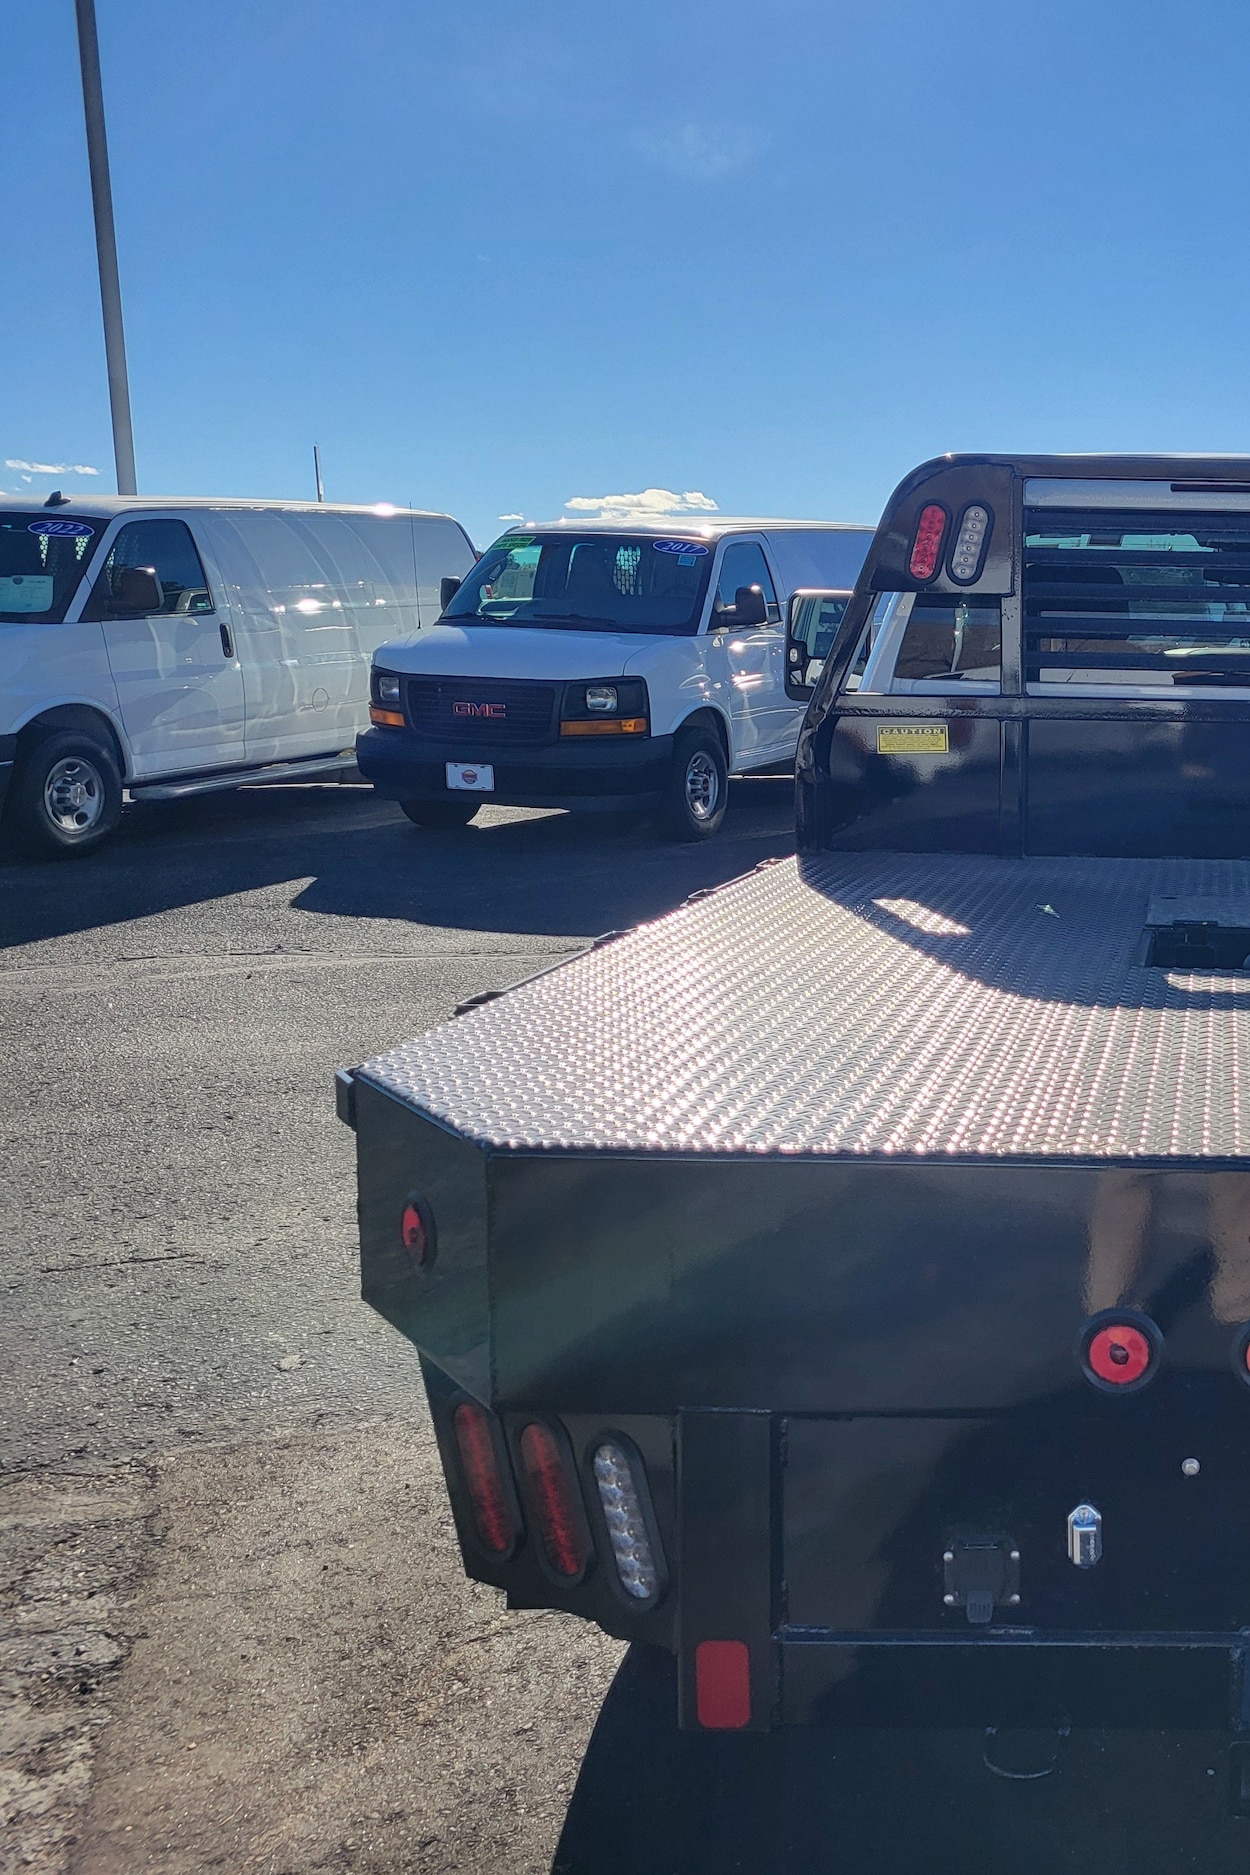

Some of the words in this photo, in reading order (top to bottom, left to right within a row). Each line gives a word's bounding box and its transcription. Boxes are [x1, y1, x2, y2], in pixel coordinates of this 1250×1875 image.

[36, 522, 84, 534] 2022
[661, 542, 702, 552] 2017
[452, 702, 506, 718] GMC
